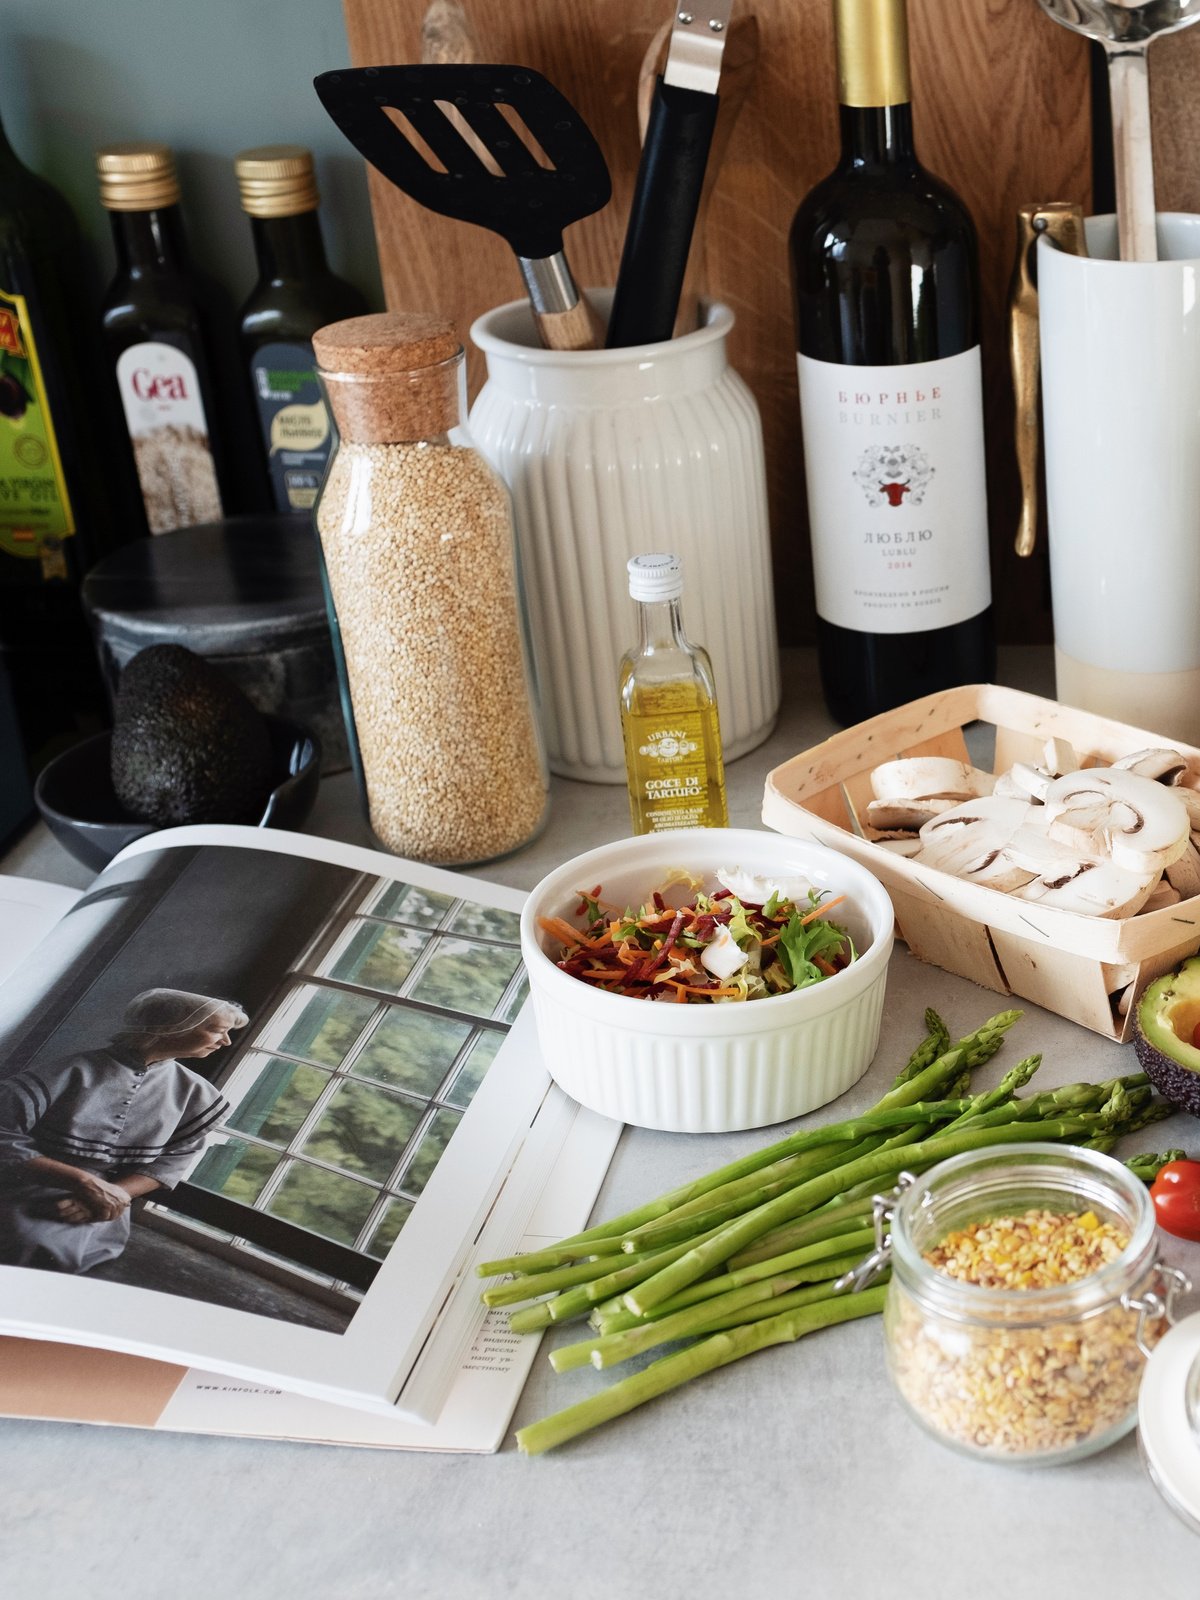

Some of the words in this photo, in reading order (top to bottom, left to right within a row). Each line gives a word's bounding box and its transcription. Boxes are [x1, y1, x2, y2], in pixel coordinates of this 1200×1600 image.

[838, 387, 941, 405] БЮРНЬЕ
[839, 408, 942, 426] BURNIER
[863, 529, 933, 544] ЛЮБЛЮ
[881, 547, 917, 557] LUBLU
[647, 730, 687, 742] URBANI
[645, 778, 681, 790] GOCCE
[685, 776, 698, 786] DI
[196, 1385, 282, 1395] WWW.KINFOLK.COM
